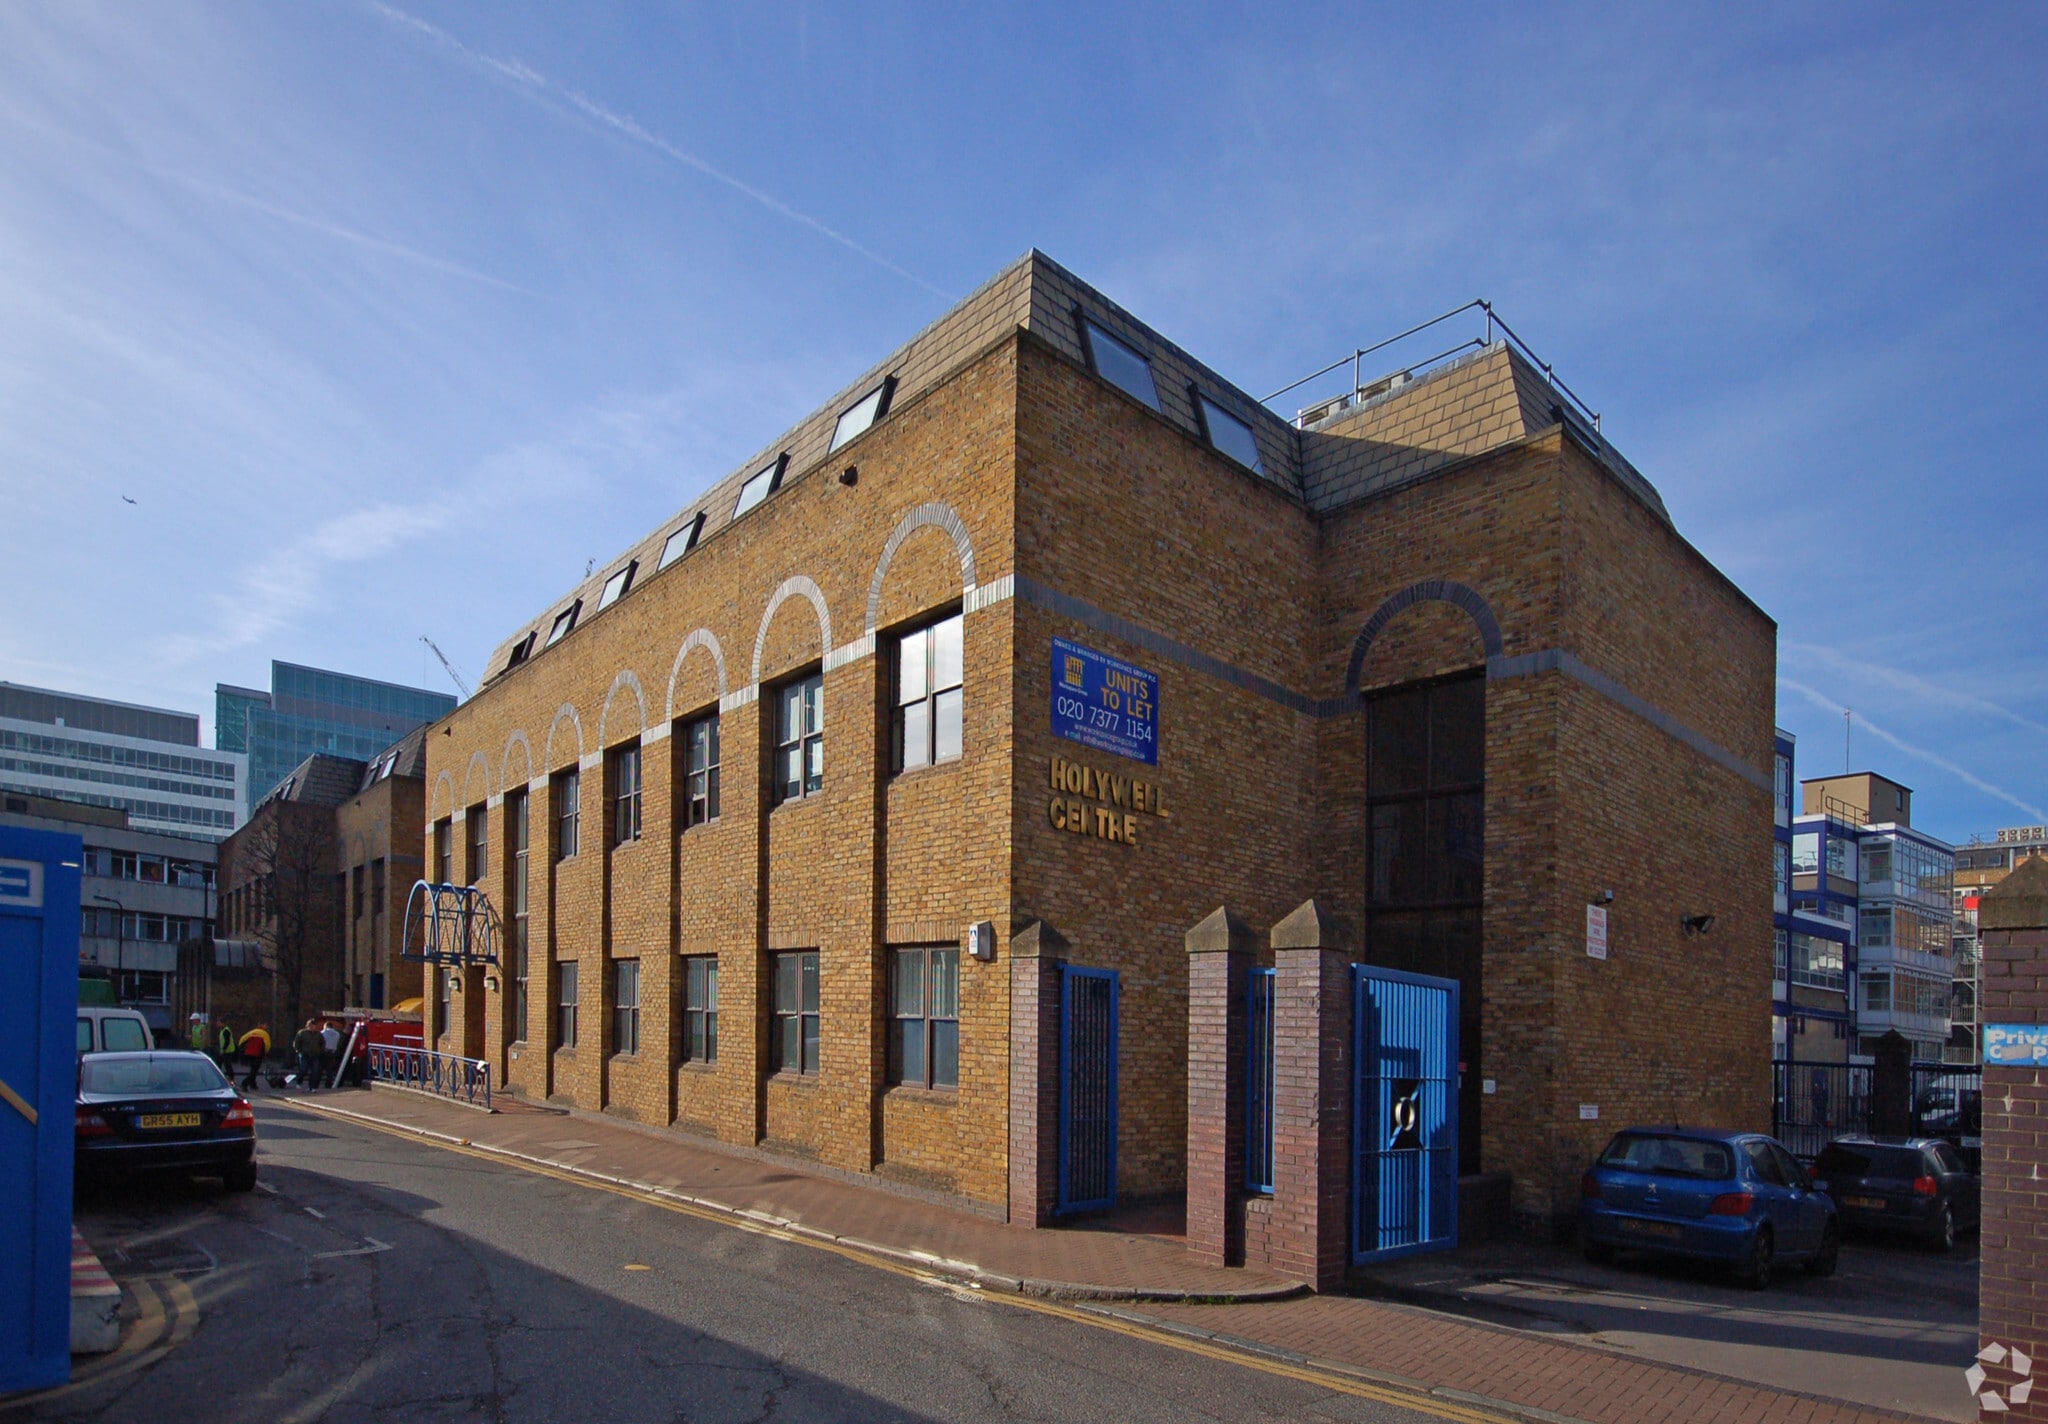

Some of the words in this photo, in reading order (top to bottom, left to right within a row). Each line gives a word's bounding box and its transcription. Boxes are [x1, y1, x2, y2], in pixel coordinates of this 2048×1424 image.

[1105, 668, 1148, 700] UNITS
[1132, 668, 1148, 680] GROUP
[1057, 696, 1084, 721] 020
[1089, 706, 1120, 732] 7377
[1126, 718, 1152, 743] 1154
[1101, 687, 1120, 710] TO
[1127, 697, 1153, 721] LET
[1050, 758, 1169, 818] HOLYWELL
[1050, 797, 1137, 846] CENTRE
[143, 1115, 173, 1127] GR55
[176, 1113, 199, 1125] AYH
